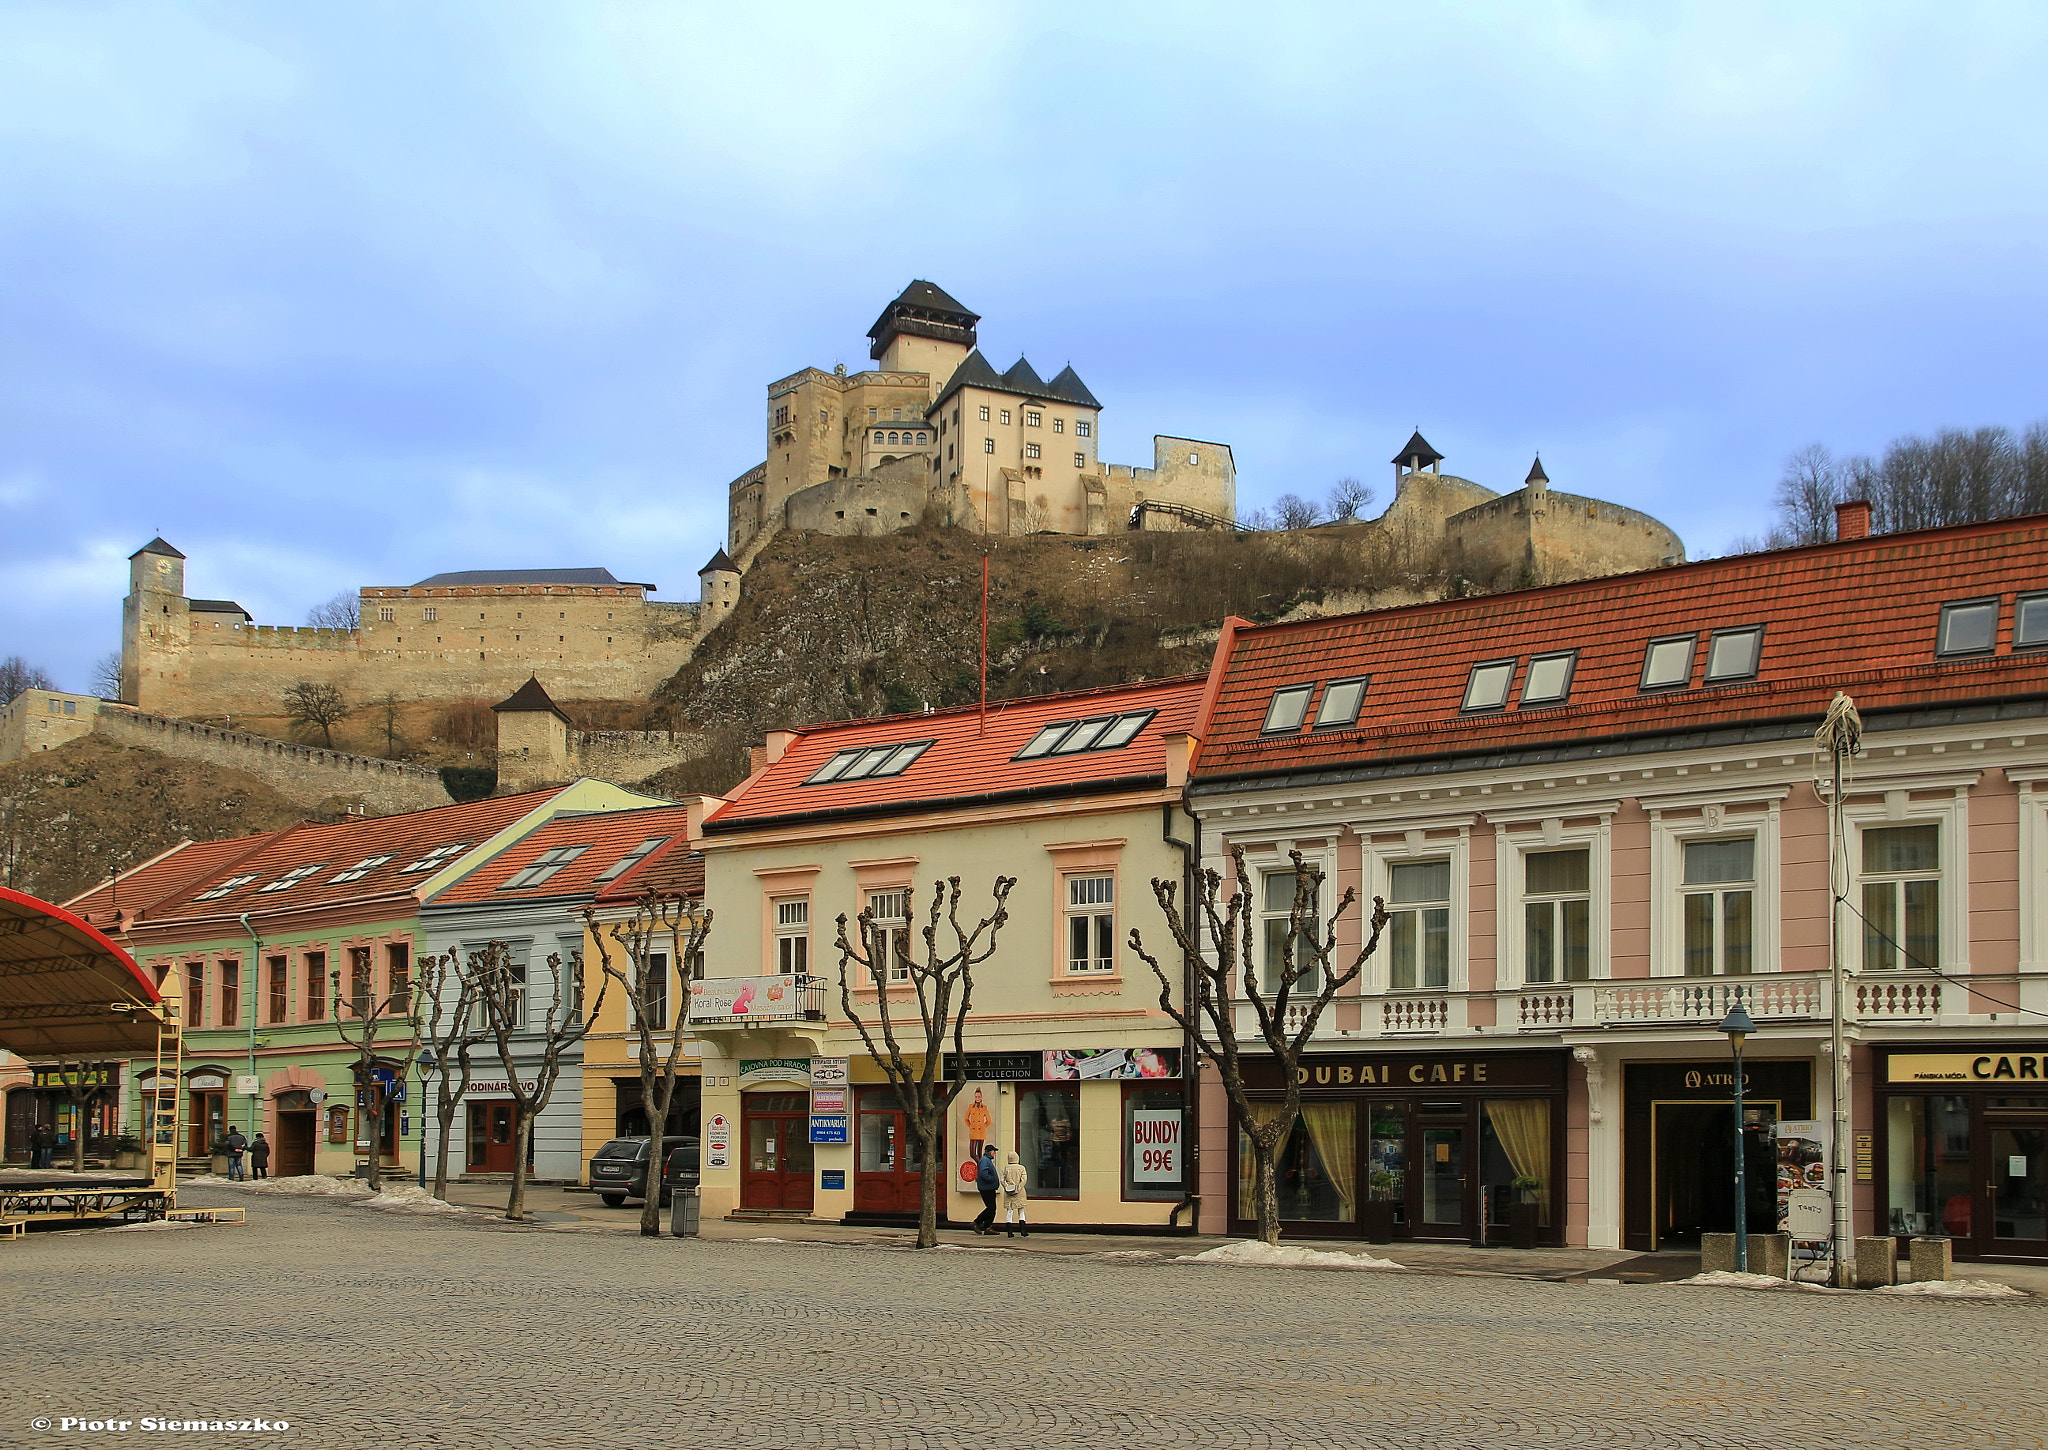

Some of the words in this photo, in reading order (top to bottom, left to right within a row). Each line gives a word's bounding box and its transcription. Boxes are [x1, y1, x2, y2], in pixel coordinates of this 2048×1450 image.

[703, 988, 722, 996] Beauty
[694, 998, 712, 1012] Koral
[714, 997, 733, 1011] Rose
[976, 1070, 1031, 1078] COLLECTION
[1297, 1065, 1389, 1085] DUBAI
[1408, 1063, 1487, 1083] CAFE
[1703, 1073, 1750, 1085] ATRO
[810, 1116, 847, 1128] ANTIKVARIÁT
[1134, 1120, 1180, 1144] BUNDY
[1142, 1149, 1173, 1172] 99€
